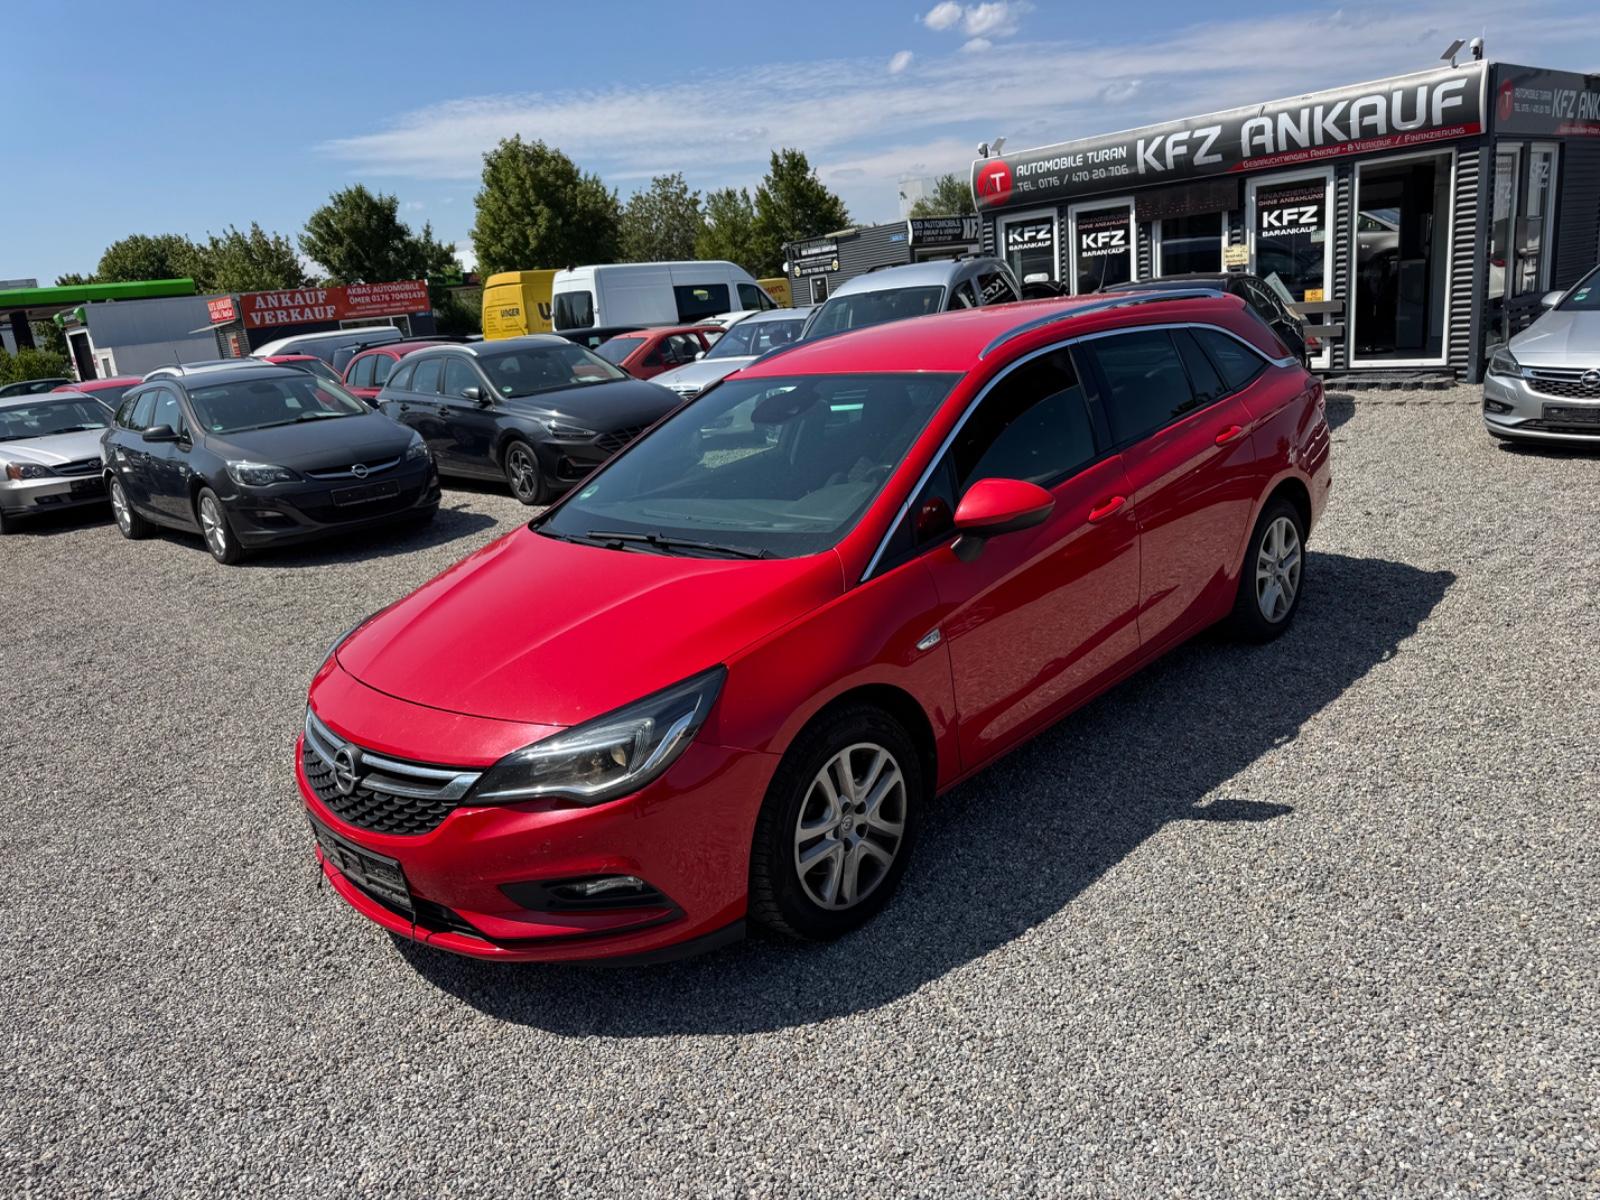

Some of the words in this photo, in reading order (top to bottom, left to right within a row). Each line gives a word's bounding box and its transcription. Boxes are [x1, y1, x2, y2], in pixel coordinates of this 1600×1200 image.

[1551, 87, 1578, 119] KFZ
[1137, 124, 1222, 174] KFZ
[1240, 78, 1468, 158] ANKAUF
[1015, 154, 1083, 177] AUTOMOBILE
[1086, 145, 1128, 164] TURAN
[1038, 176, 1060, 189] 0176
[1062, 173, 1070, 185] /
[1072, 170, 1090, 183] 470
[1091, 167, 1107, 180] 20
[1107, 164, 1130, 177] 706
[1262, 204, 1318, 229] KFZ
[962, 217, 979, 240] KF
[1008, 223, 1052, 244] KFZ
[1262, 225, 1317, 238] BARANKAUF
[1008, 240, 1052, 252] BARANKAUF
[1082, 229, 1126, 250] KFZ
[1082, 246, 1125, 258] BARANKAUF
[255, 290, 327, 309] ANKAUF
[249, 305, 336, 325] VERKAUF
